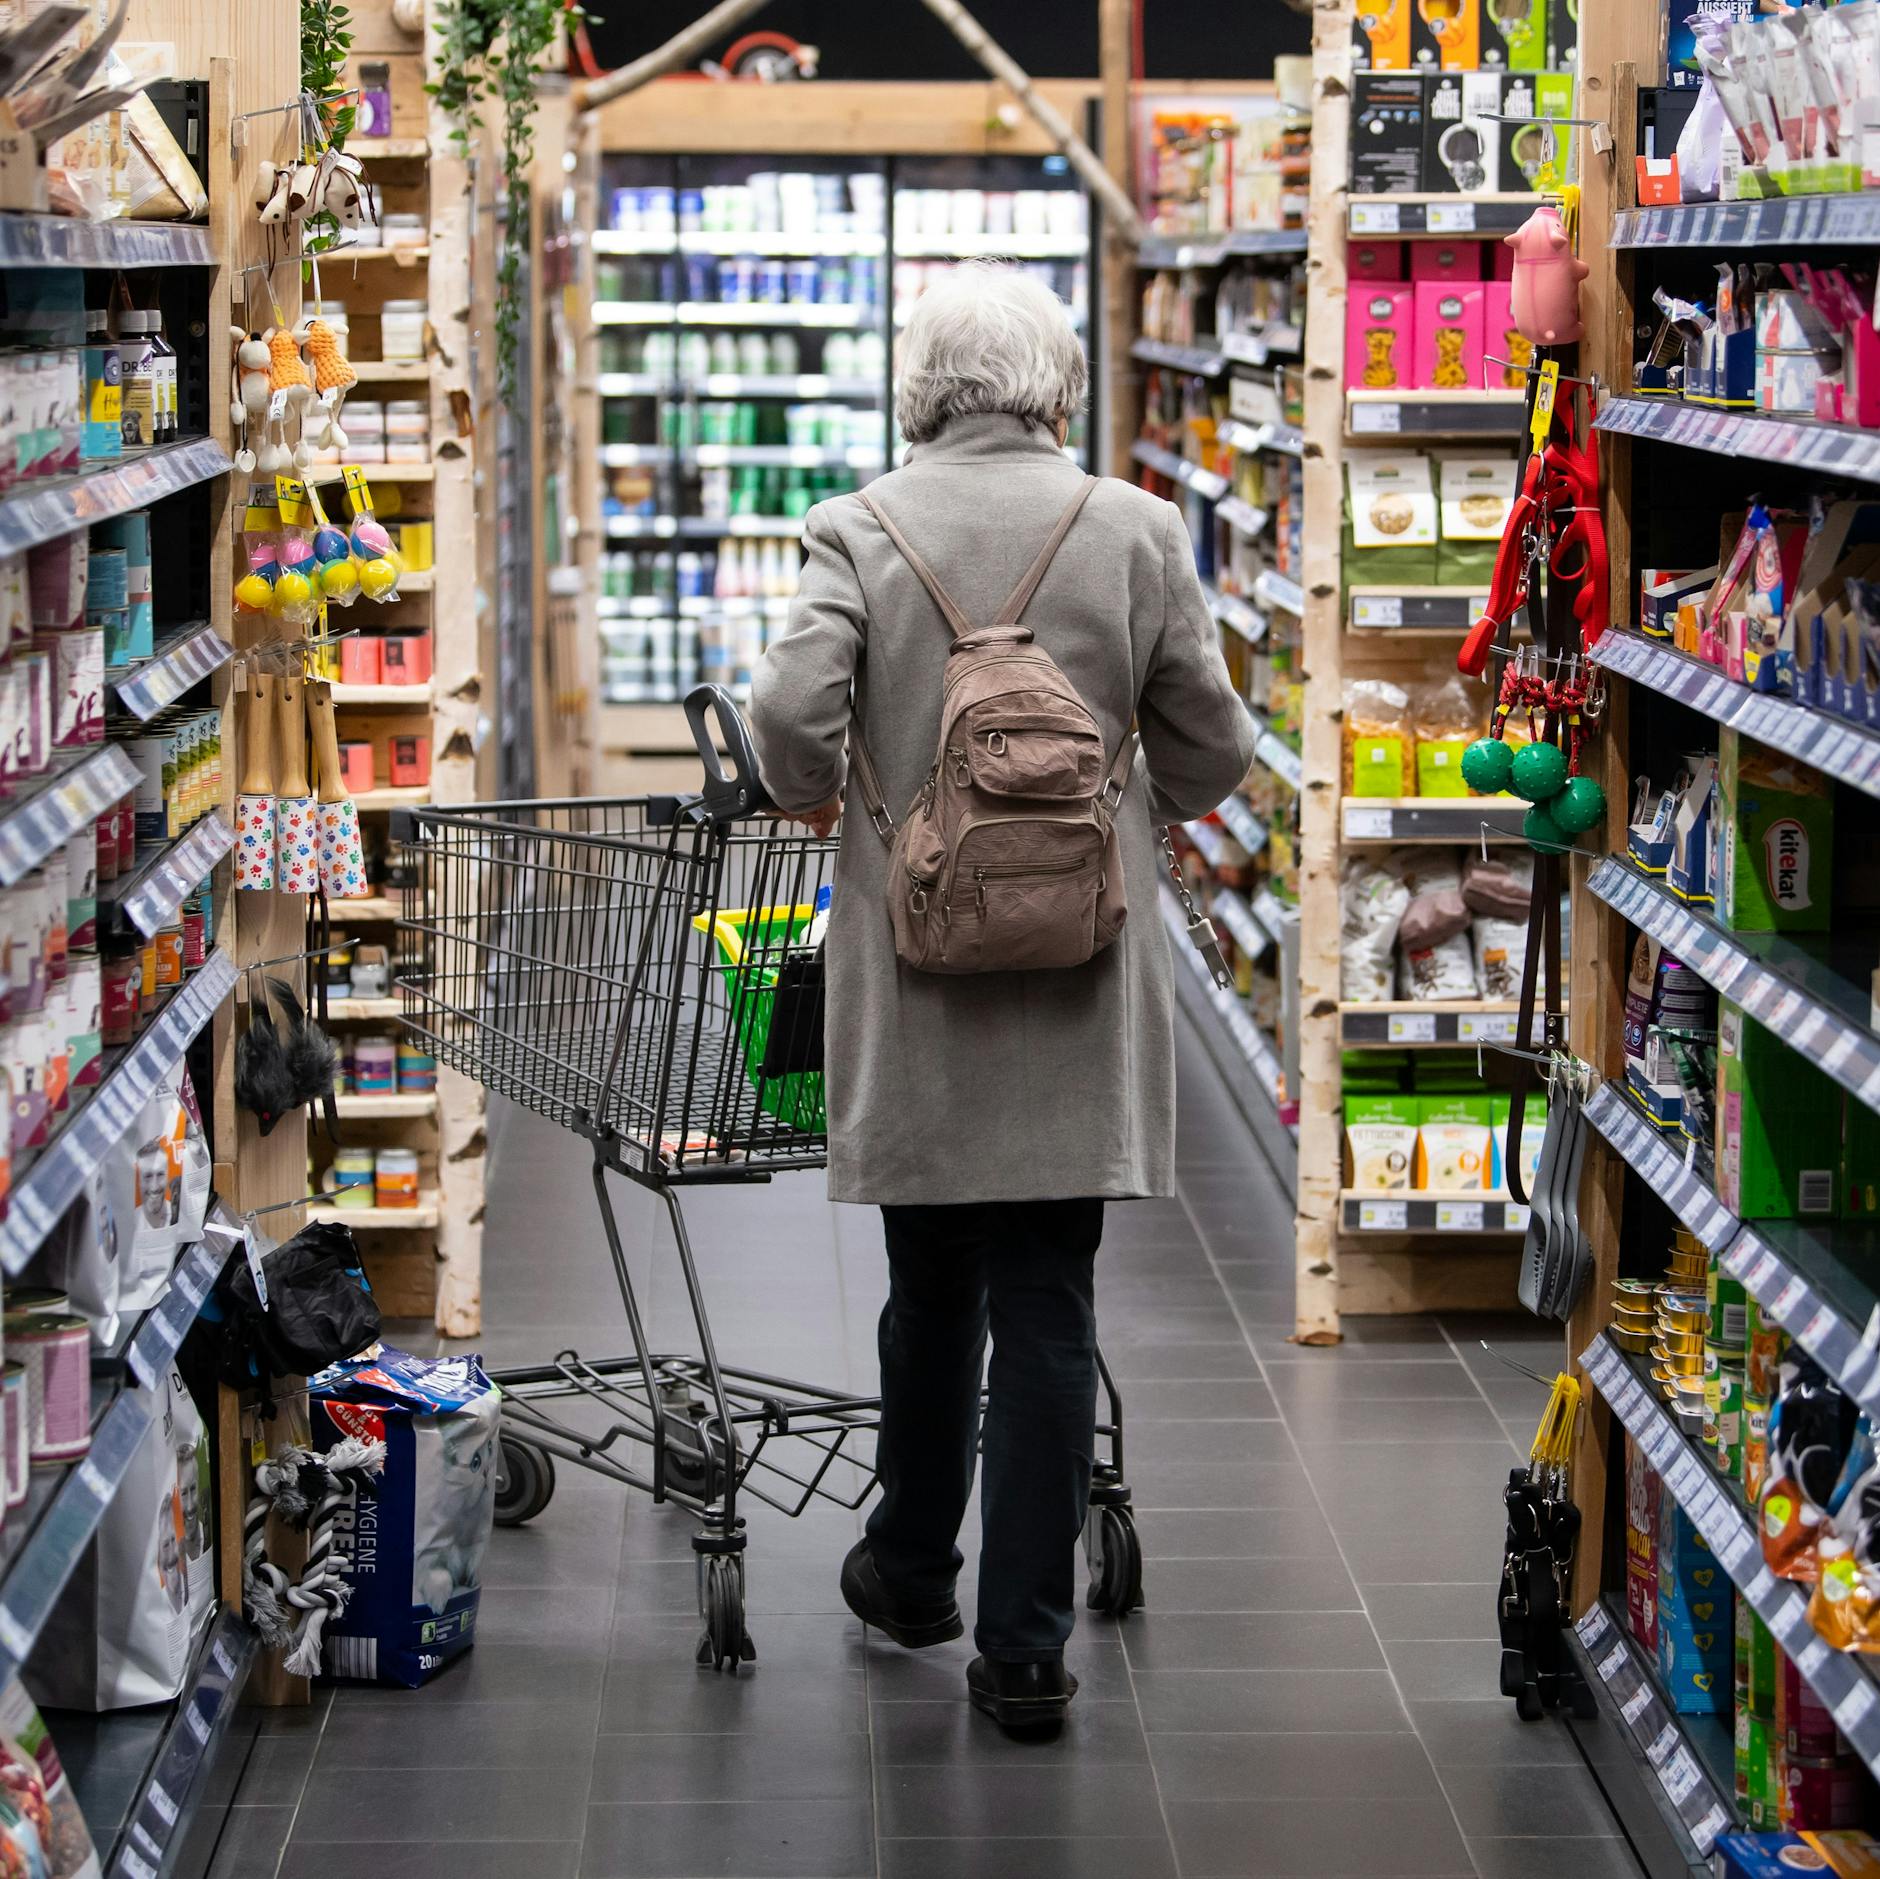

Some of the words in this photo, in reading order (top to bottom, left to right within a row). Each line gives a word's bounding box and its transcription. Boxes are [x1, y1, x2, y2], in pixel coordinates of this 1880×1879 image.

[1779, 828, 1800, 900] kitekat
[335, 1404, 376, 1445] GÜNSTI
[418, 1654, 433, 1670] 20
